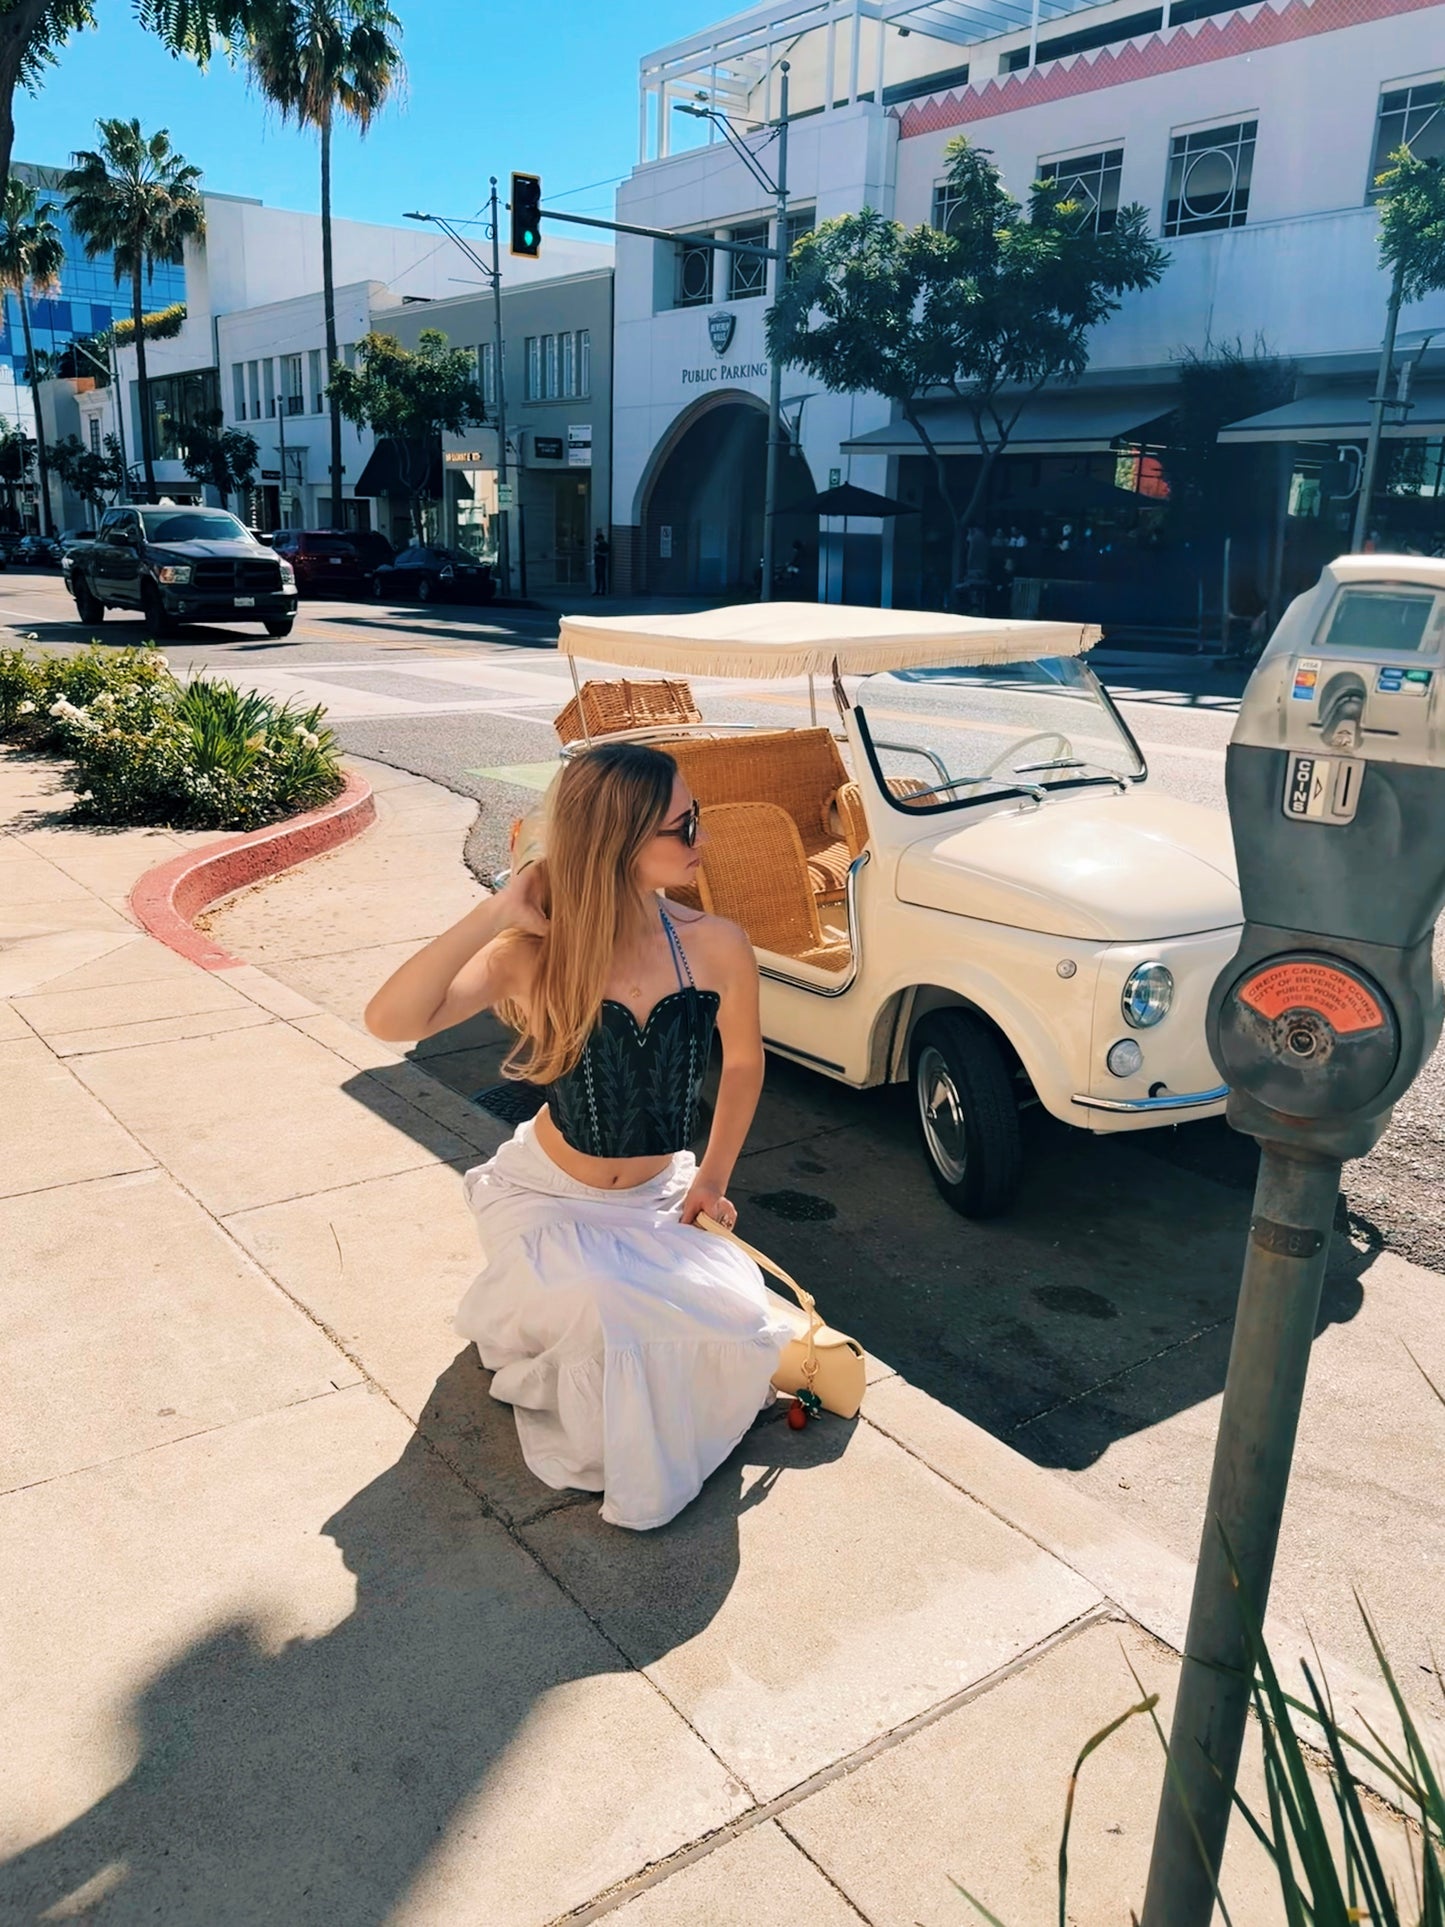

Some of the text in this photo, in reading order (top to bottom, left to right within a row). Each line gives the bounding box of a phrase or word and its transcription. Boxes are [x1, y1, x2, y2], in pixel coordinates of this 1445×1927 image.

[682, 363, 768, 384] PUBLIC PARKING
[1293, 761, 1311, 812] COINS
[1248, 967, 1376, 1021] CREDIT CARD OR COINS
[1253, 977, 1368, 1023] CITY OF BEVERLY HILLS
[1276, 985, 1347, 1009] PUBLIC WORKS
